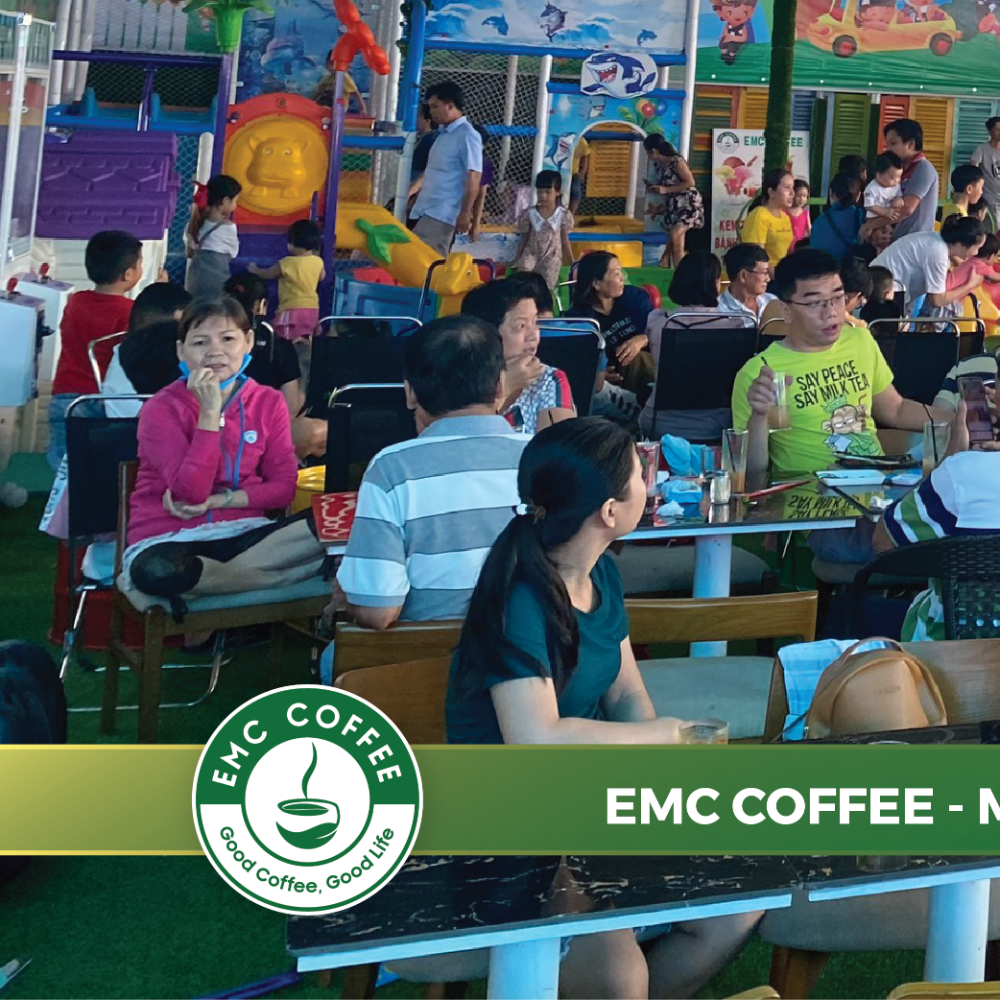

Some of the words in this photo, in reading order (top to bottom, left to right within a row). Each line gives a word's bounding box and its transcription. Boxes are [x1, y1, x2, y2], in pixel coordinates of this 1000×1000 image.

[794, 389, 819, 409] SAY
[819, 380, 849, 402] MILK
[848, 373, 870, 393] TEA
[796, 371, 820, 391] SAY
[821, 360, 858, 384] PEACE
